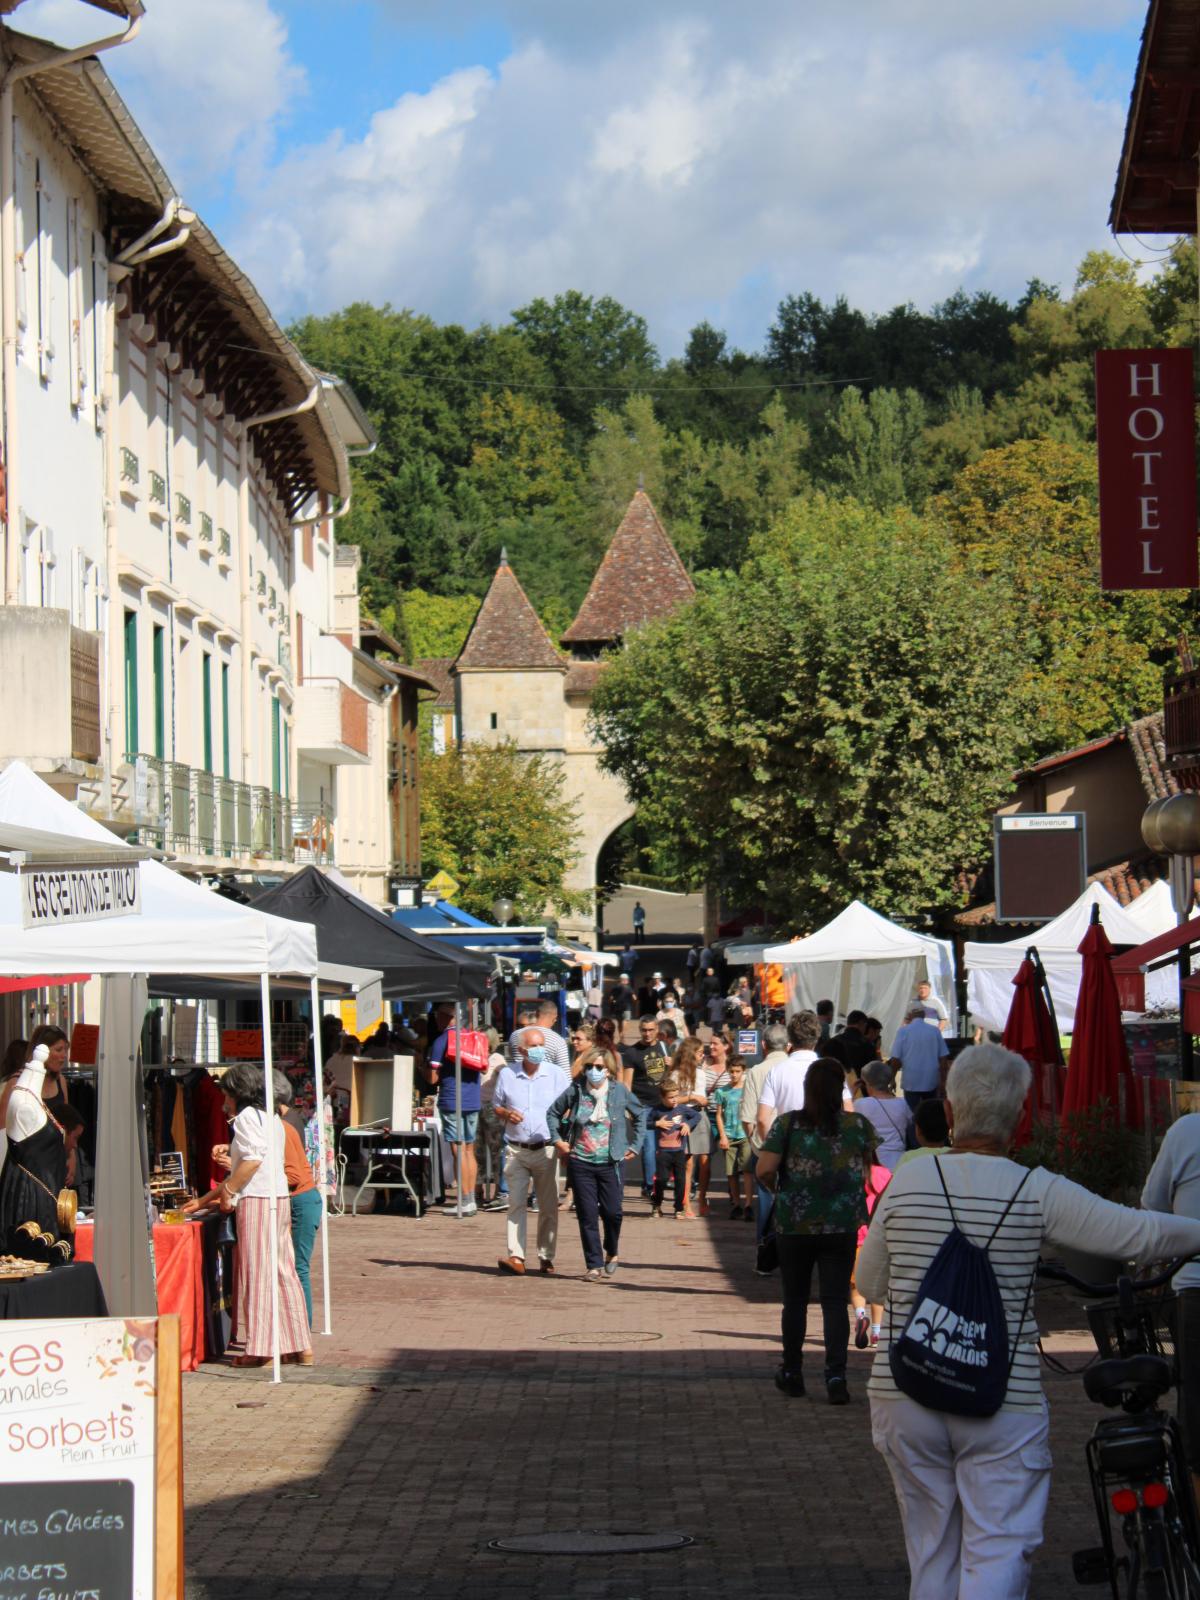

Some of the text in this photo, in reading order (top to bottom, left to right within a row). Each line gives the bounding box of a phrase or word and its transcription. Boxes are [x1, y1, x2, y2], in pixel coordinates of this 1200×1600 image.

[1128, 363, 1164, 575] HOTEL
[0, 1340, 64, 1377] es
[944, 1342, 988, 1367] VALOIS
[8, 1411, 134, 1452] Sorbets
[61, 1440, 138, 1463] Plein Fruit
